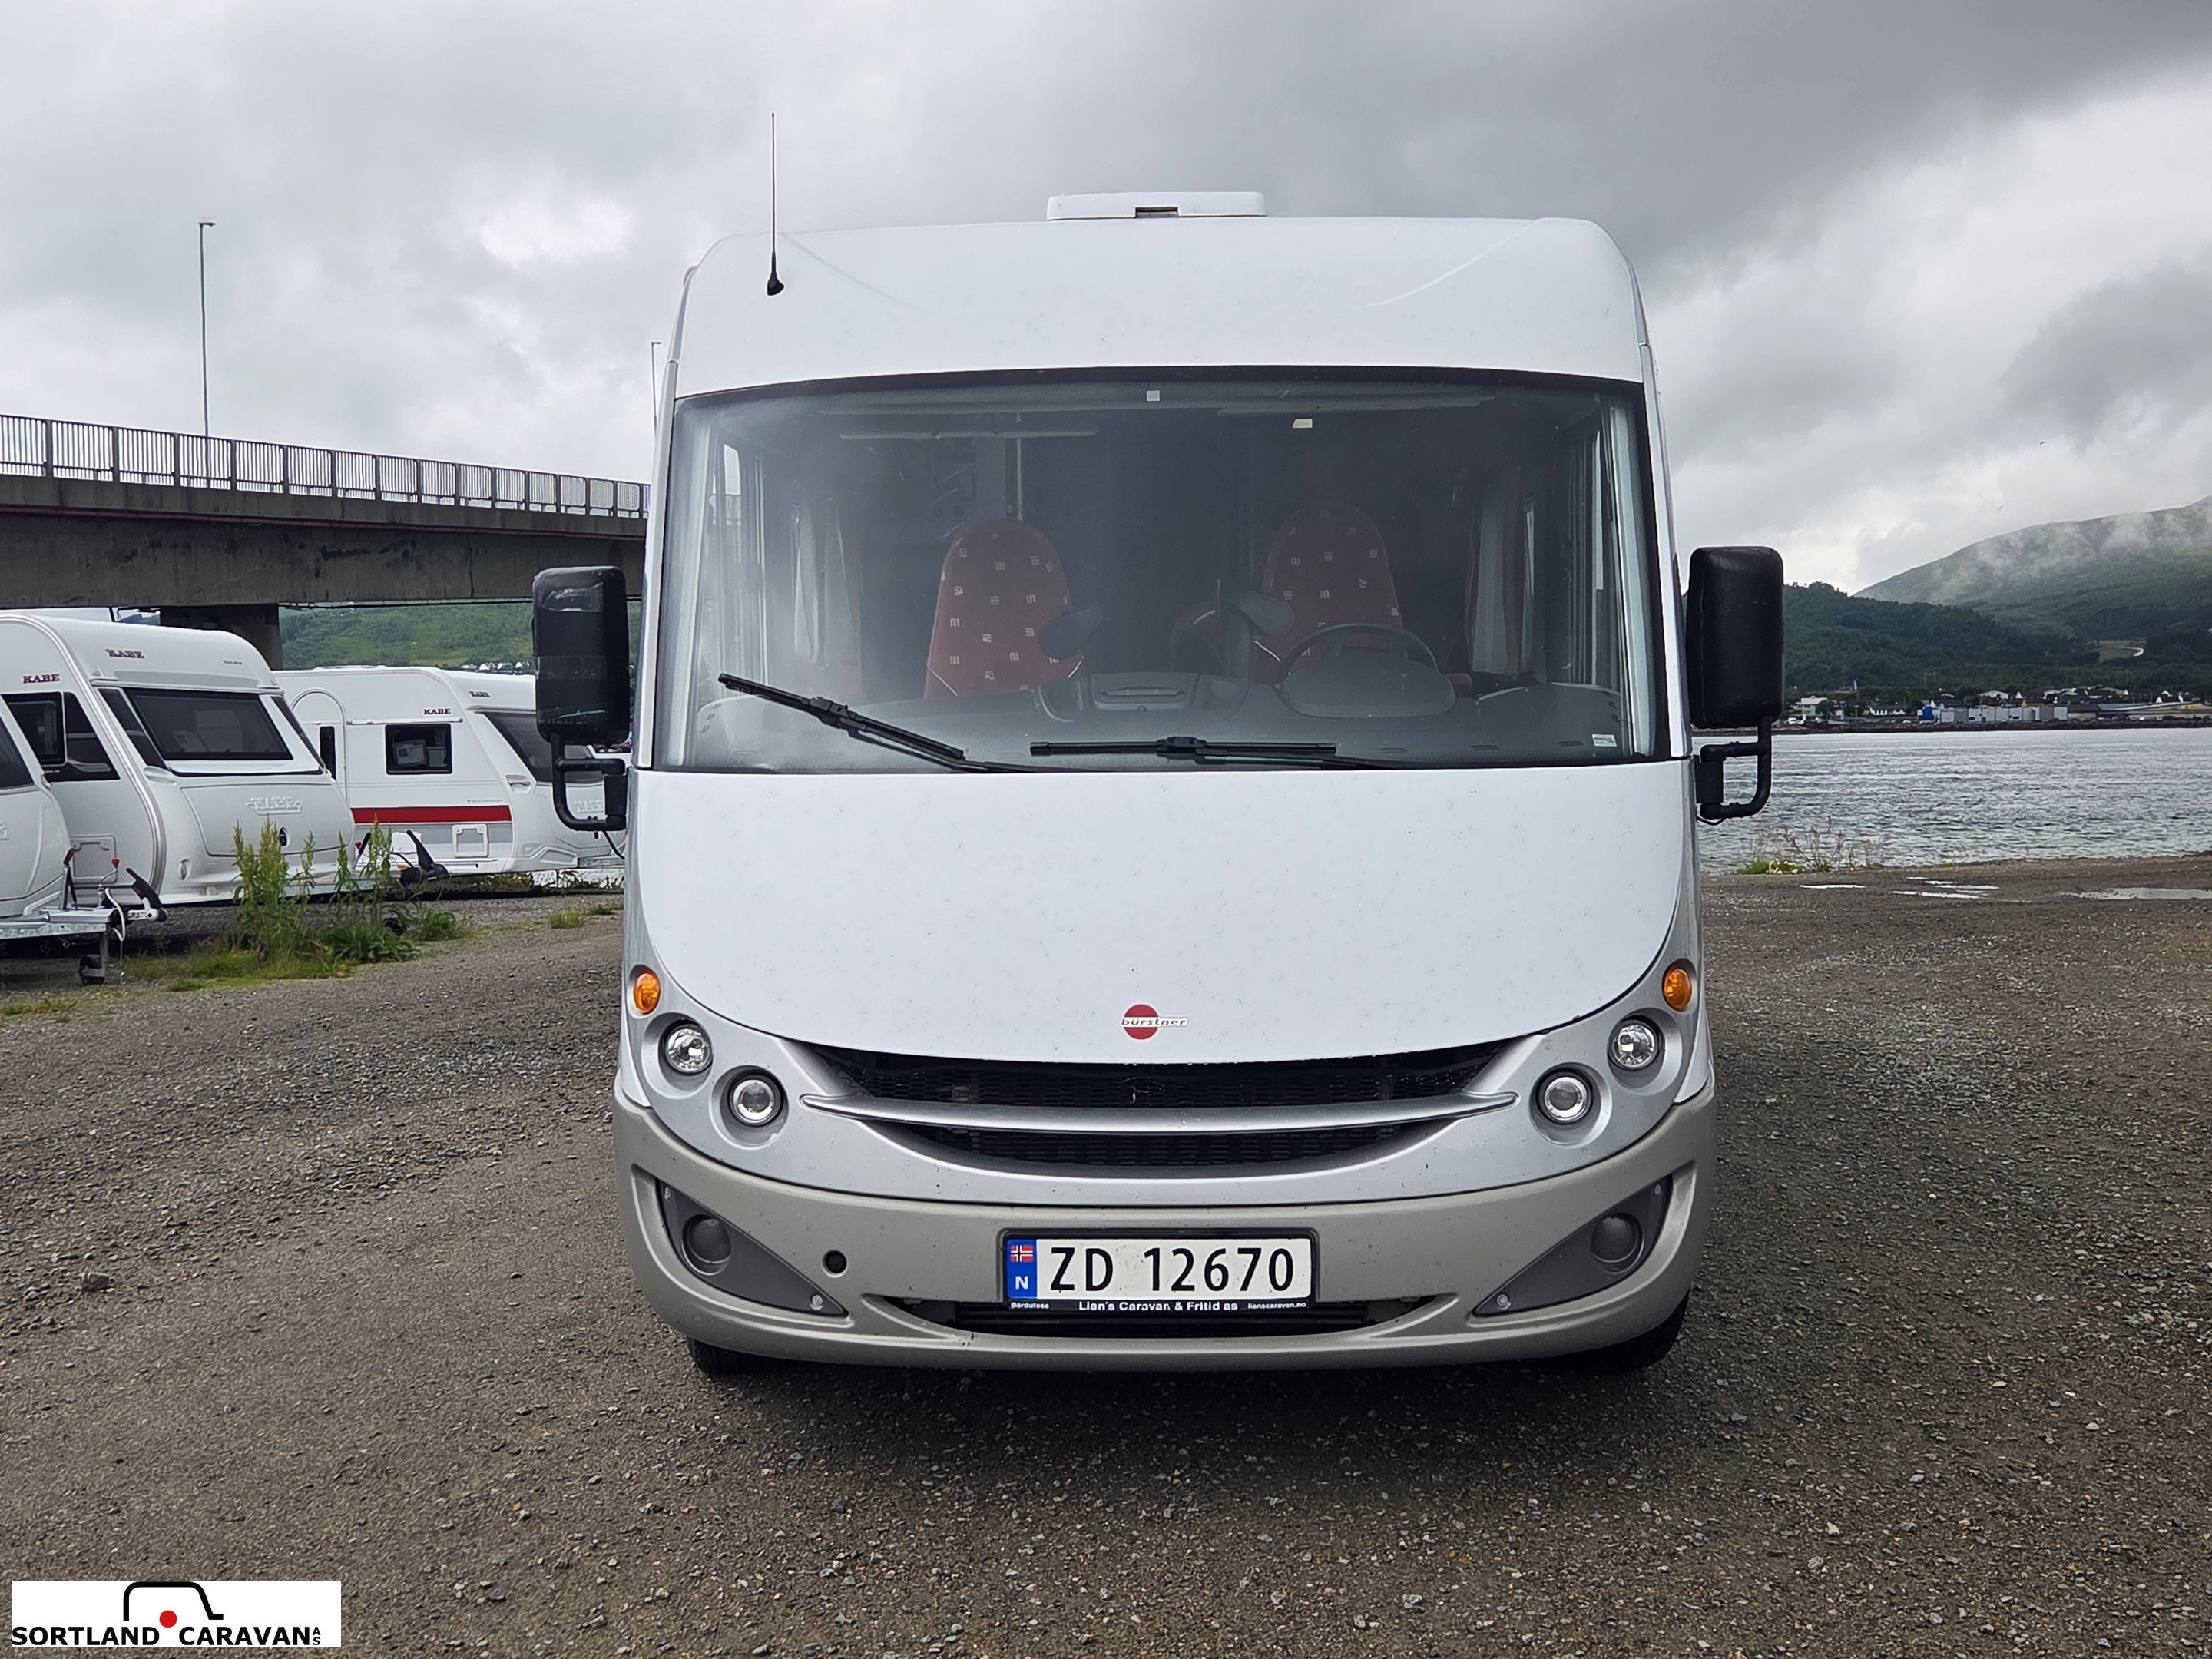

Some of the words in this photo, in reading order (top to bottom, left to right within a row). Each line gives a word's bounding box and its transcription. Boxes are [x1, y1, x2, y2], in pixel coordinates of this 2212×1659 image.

[23, 674, 60, 684] KABE
[1050, 1247, 1113, 1291] ZD
[1144, 1247, 1293, 1291] 12670
[1015, 1276, 1028, 1290] N
[1119, 1302, 1171, 1311] Caravan
[1174, 1302, 1183, 1311] &
[1187, 1302, 1220, 1311] Fritid
[1224, 1303, 1238, 1311] as
